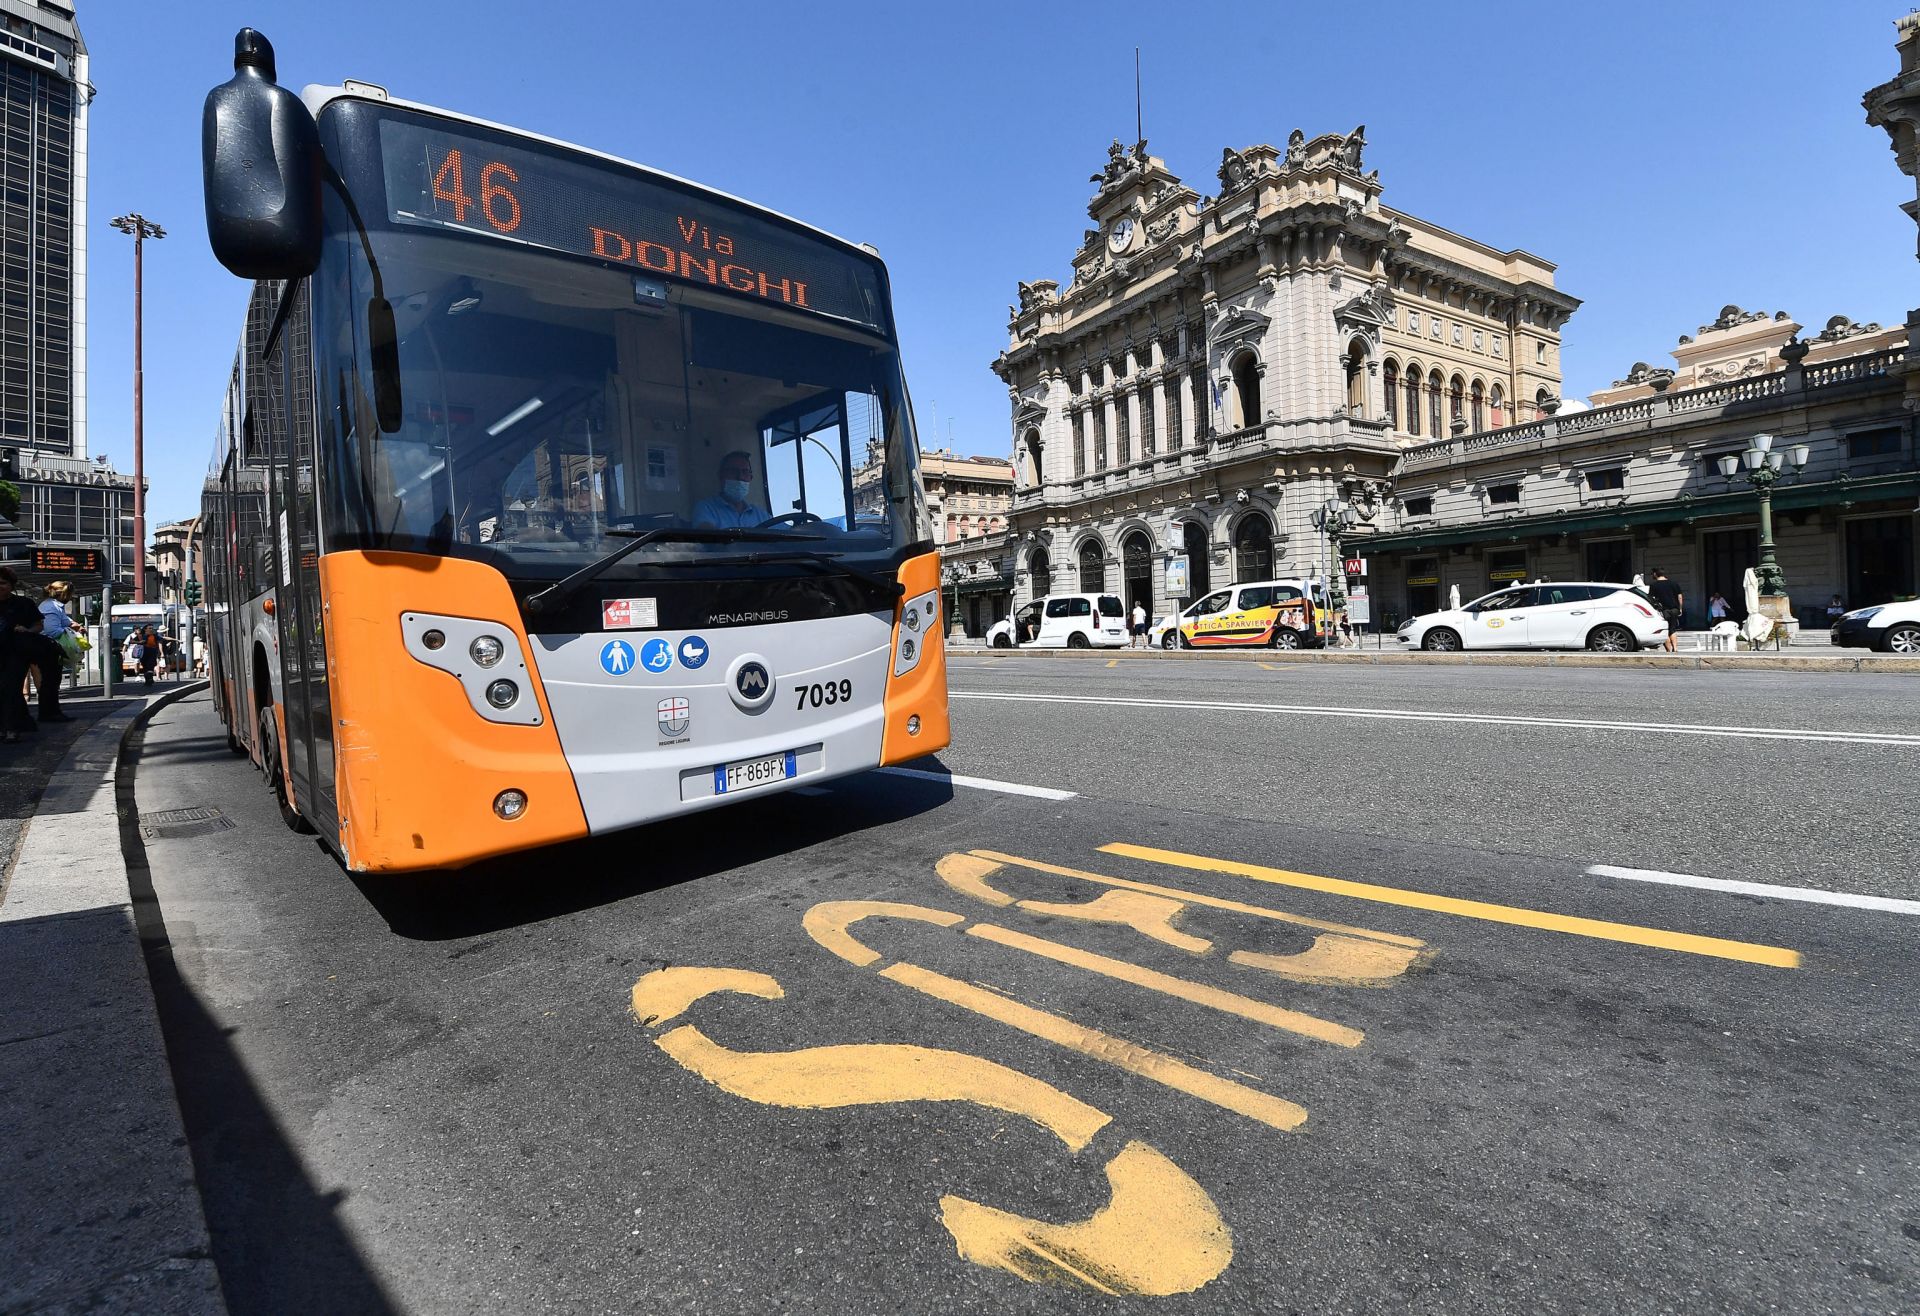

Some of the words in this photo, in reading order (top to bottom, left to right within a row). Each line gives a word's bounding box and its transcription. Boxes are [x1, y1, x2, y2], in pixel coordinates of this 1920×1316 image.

[433, 148, 522, 233] 46
[677, 216, 734, 256] Via
[588, 226, 809, 308] DONGHI
[708, 610, 789, 625] MENARINIBUS
[741, 670, 766, 691] M
[794, 678, 853, 711] 7039
[631, 849, 1429, 1297] BUS
